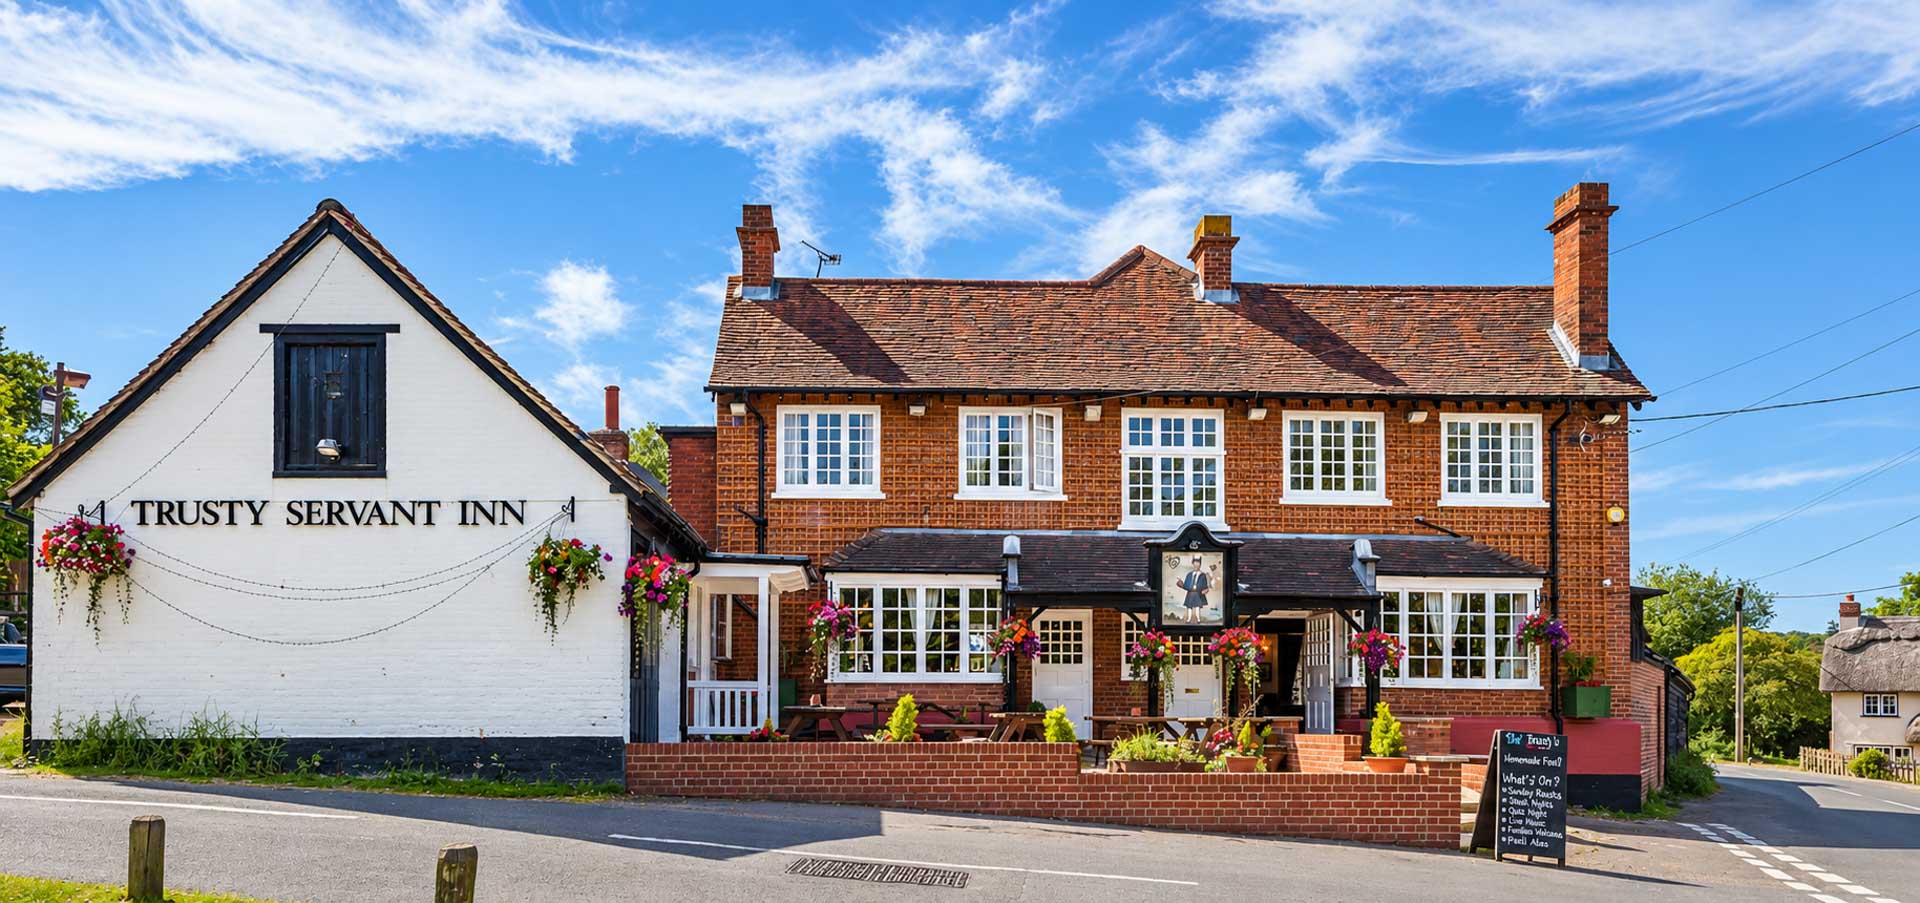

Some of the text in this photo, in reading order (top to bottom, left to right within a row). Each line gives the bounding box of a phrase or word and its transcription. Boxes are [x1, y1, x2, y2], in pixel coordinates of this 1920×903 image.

[131, 499, 527, 527] TRUSTY SERVANT INN
